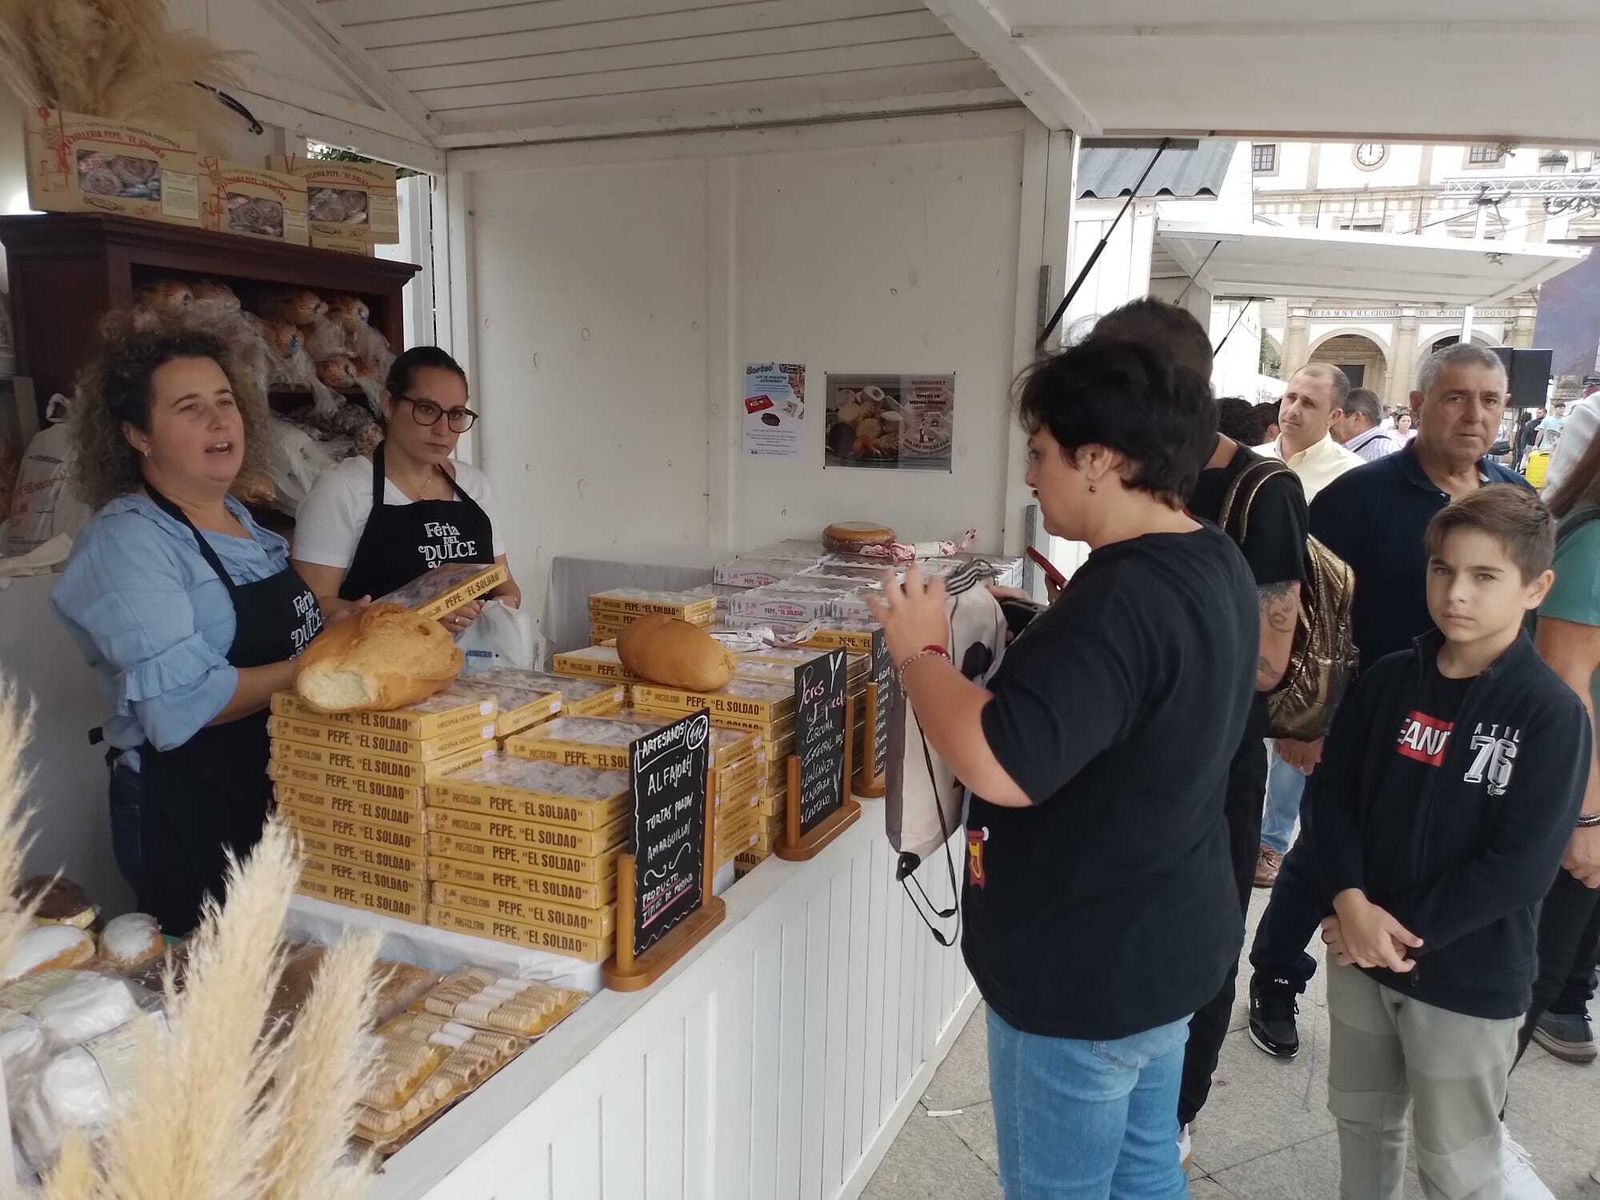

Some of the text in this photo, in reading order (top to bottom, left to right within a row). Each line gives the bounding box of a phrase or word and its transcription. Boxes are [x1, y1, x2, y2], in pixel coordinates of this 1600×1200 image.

[424, 522, 460, 538] Feria
[443, 536, 459, 545] DEL
[418, 541, 477, 561] DULCE
[293, 590, 315, 617] Feria
[711, 700, 725, 711] "EL
[726, 701, 764, 716] SOLDAO"
[356, 712, 370, 726] "EL
[372, 715, 412, 732] SOLDAO"
[356, 734, 371, 748] "EL
[372, 737, 413, 754] SOLDAO"
[358, 758, 373, 771] "EL
[374, 761, 416, 778] SOLDAO"
[593, 755, 608, 767] "EL
[1463, 735, 1518, 788] 76
[353, 779, 368, 792] "EL
[370, 782, 410, 800] SOLDAO"
[359, 802, 373, 816] "EL
[374, 806, 414, 824] SOLDAO"
[520, 802, 534, 816] "EL
[538, 804, 582, 822] SOLDAO"
[360, 826, 374, 840] "EL
[376, 830, 416, 848] SOLDAO"
[520, 827, 534, 842] "EL
[538, 830, 582, 848] SOLDAO"
[362, 850, 376, 862] "EL
[376, 854, 416, 872] SOLDAO"
[522, 851, 539, 866] "EL
[542, 854, 586, 873] SOLDAO"
[358, 870, 373, 884] "EL
[374, 874, 414, 892] SOLDAO"
[523, 878, 540, 892] "EL
[542, 881, 588, 900] SOLDAO"
[361, 892, 376, 906] "EL
[376, 896, 416, 915] SOLDAO"
[528, 905, 544, 920] "EL
[548, 910, 593, 929] SOLDAO"
[524, 930, 540, 944] "EL
[542, 934, 588, 952] SOLDAO"
